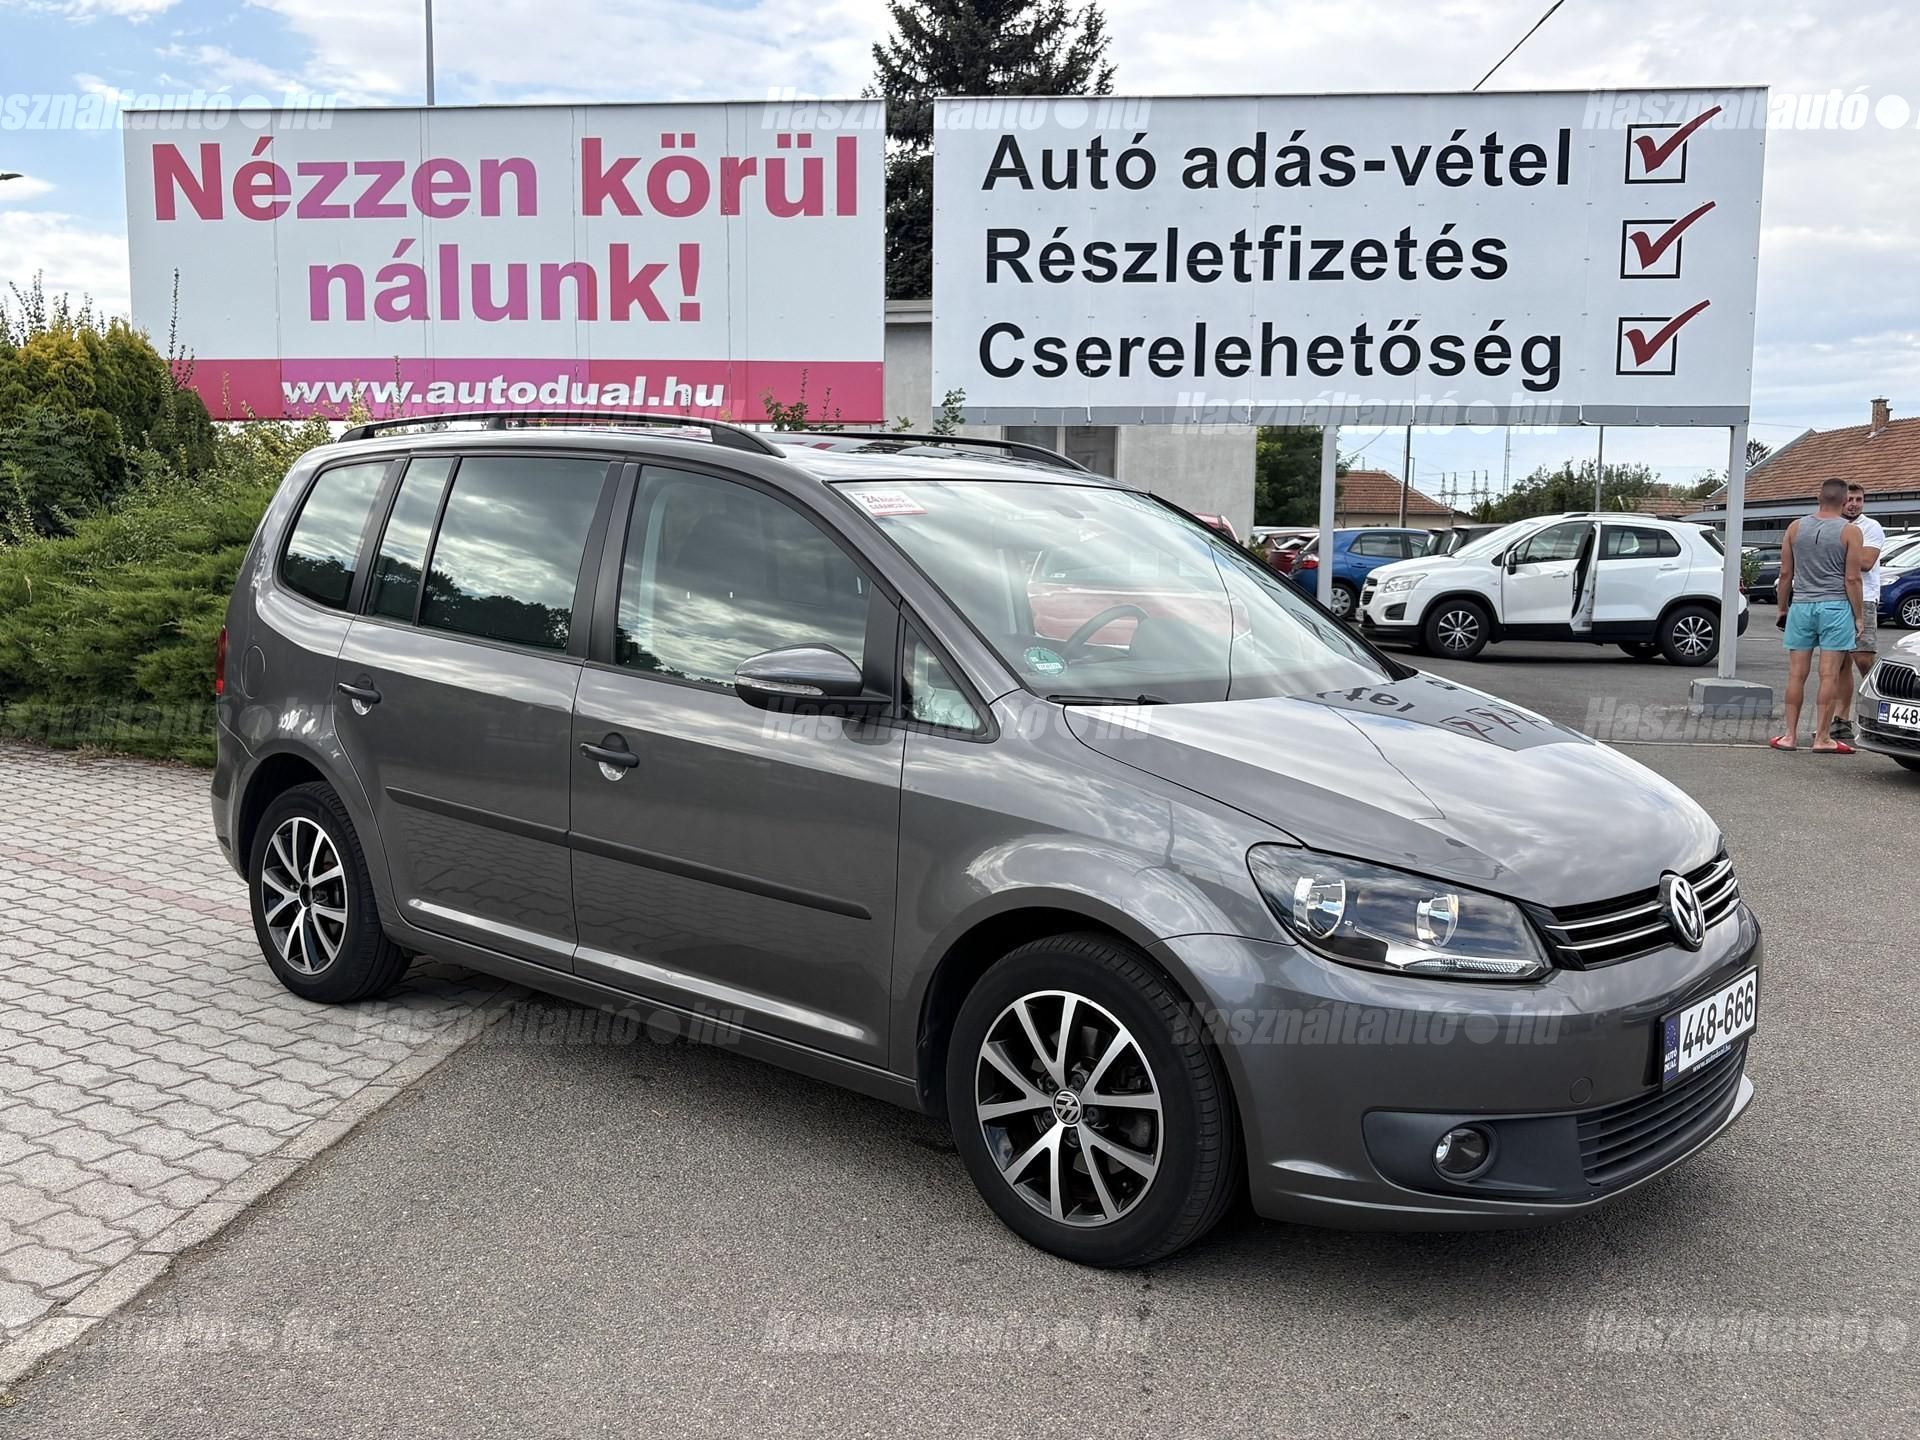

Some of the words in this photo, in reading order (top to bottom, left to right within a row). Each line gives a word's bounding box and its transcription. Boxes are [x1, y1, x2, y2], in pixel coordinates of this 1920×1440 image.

[153, 137, 538, 221] Nézzen
[582, 133, 858, 218] körül
[981, 132, 1157, 191] Autó
[1182, 128, 1571, 190] adás-vétel
[310, 239, 701, 322] nálunk!
[985, 223, 1508, 284] Részletfizetés
[281, 375, 725, 408] www.autodual.hu
[979, 320, 1561, 392] Cserelehetőség
[1682, 980, 1754, 1059] 448-666
